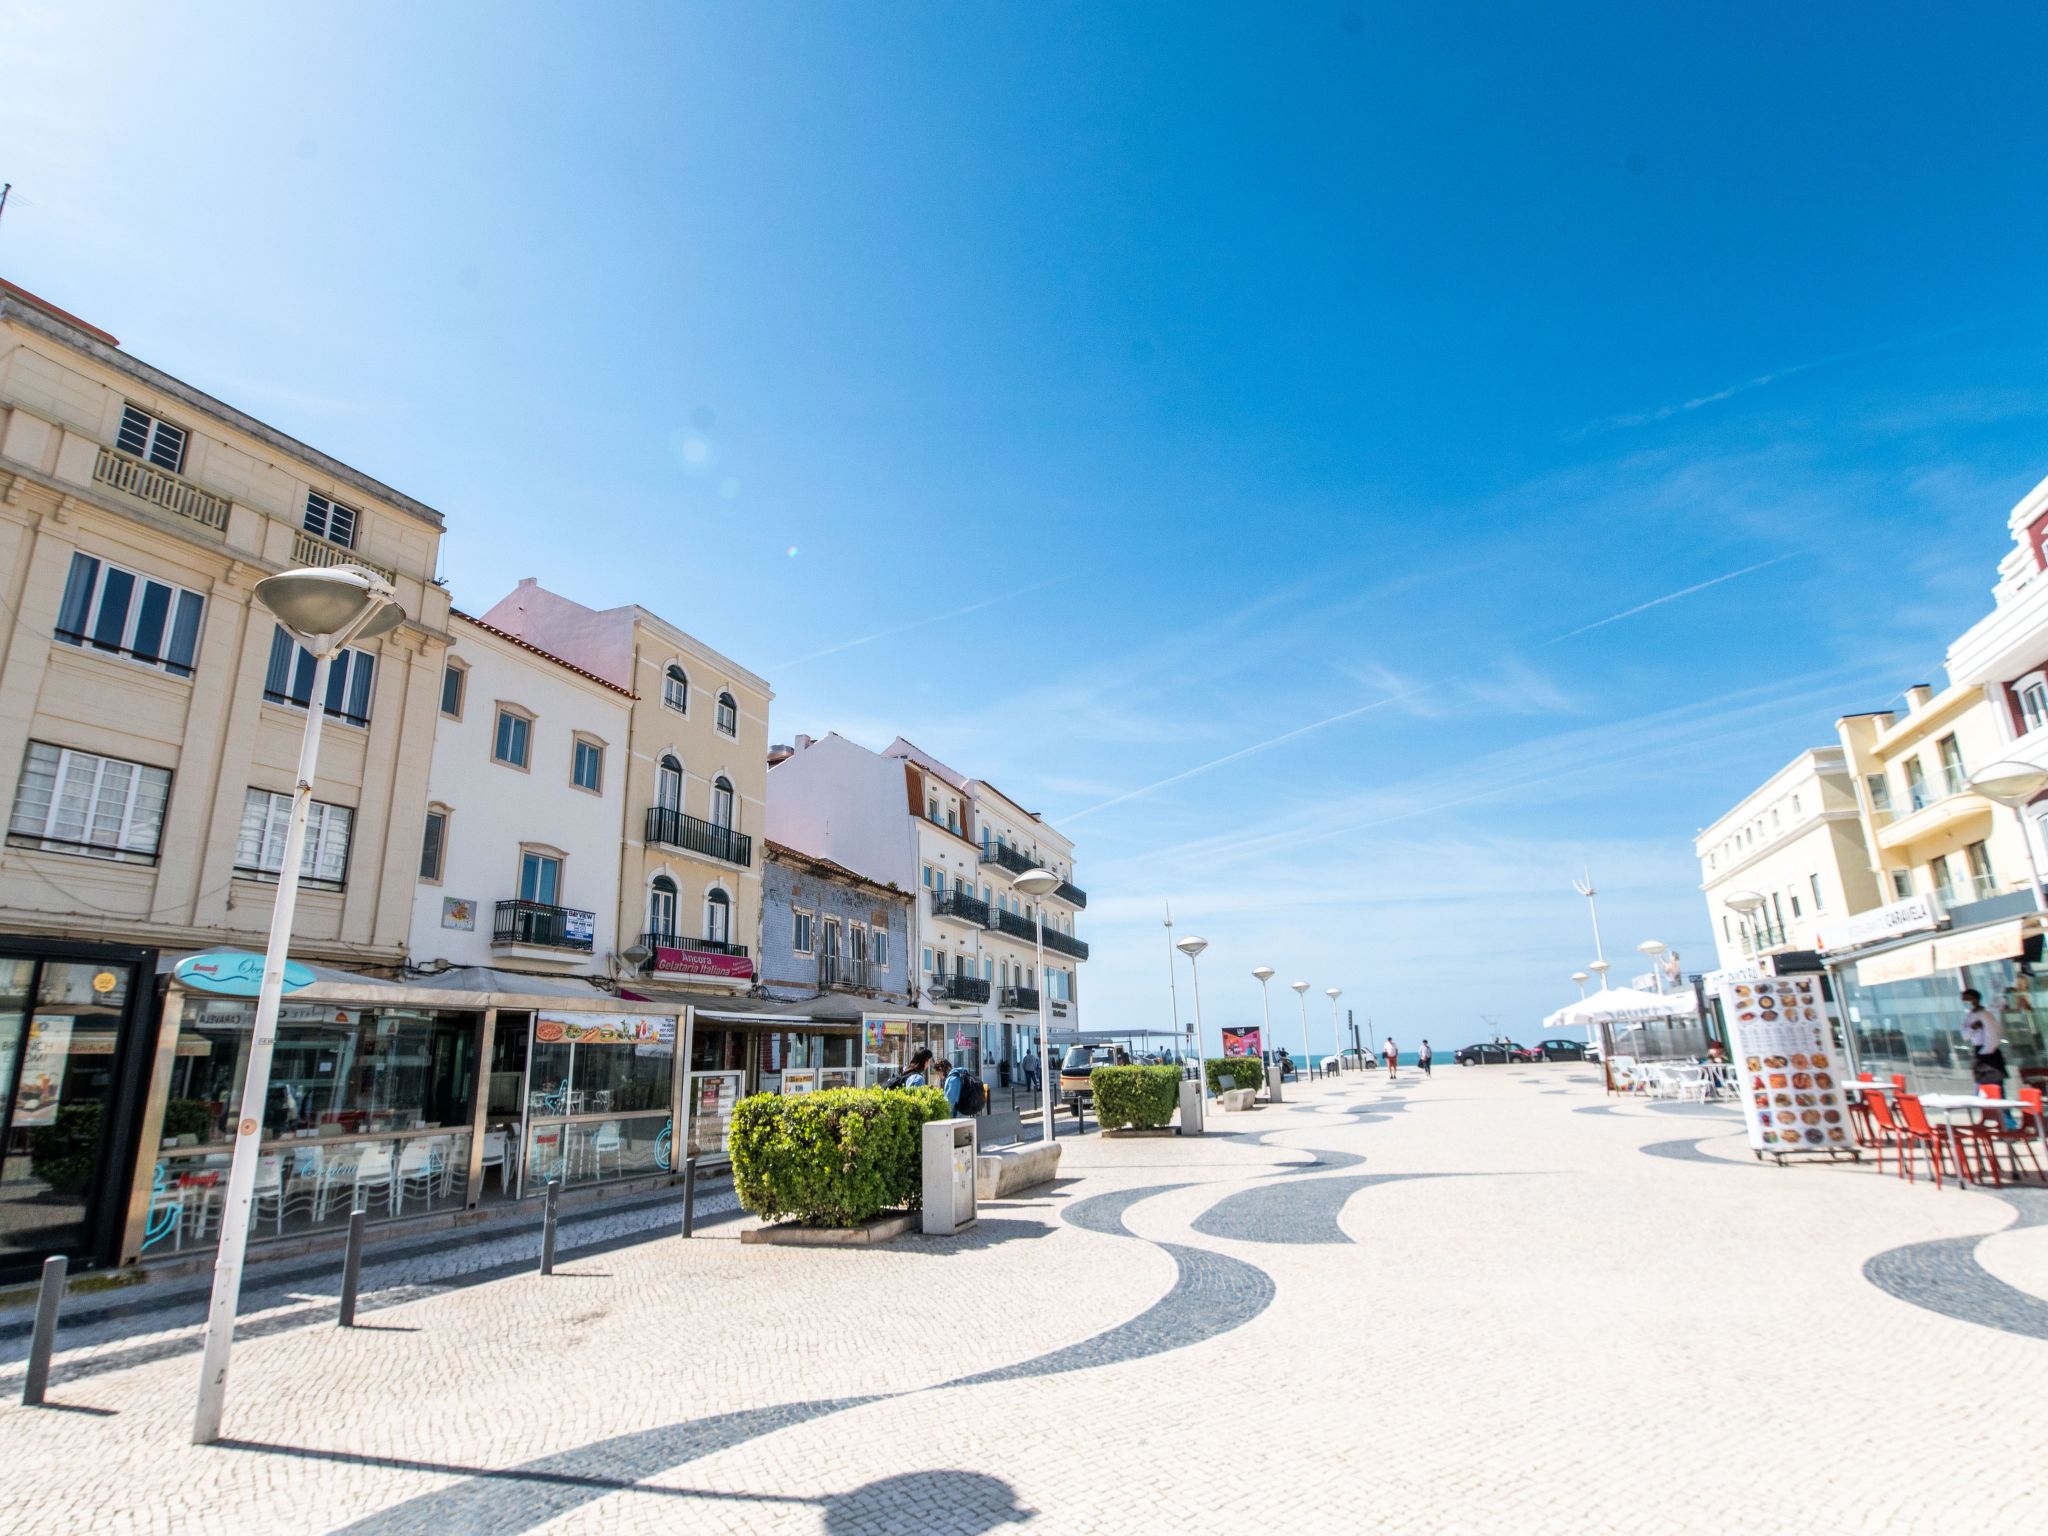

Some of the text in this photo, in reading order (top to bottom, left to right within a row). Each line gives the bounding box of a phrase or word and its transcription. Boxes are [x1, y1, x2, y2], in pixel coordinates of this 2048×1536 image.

[1885, 903, 1928, 927] CARAVELA
[659, 960, 698, 974] Gelataria
[699, 964, 731, 977] Italiana
